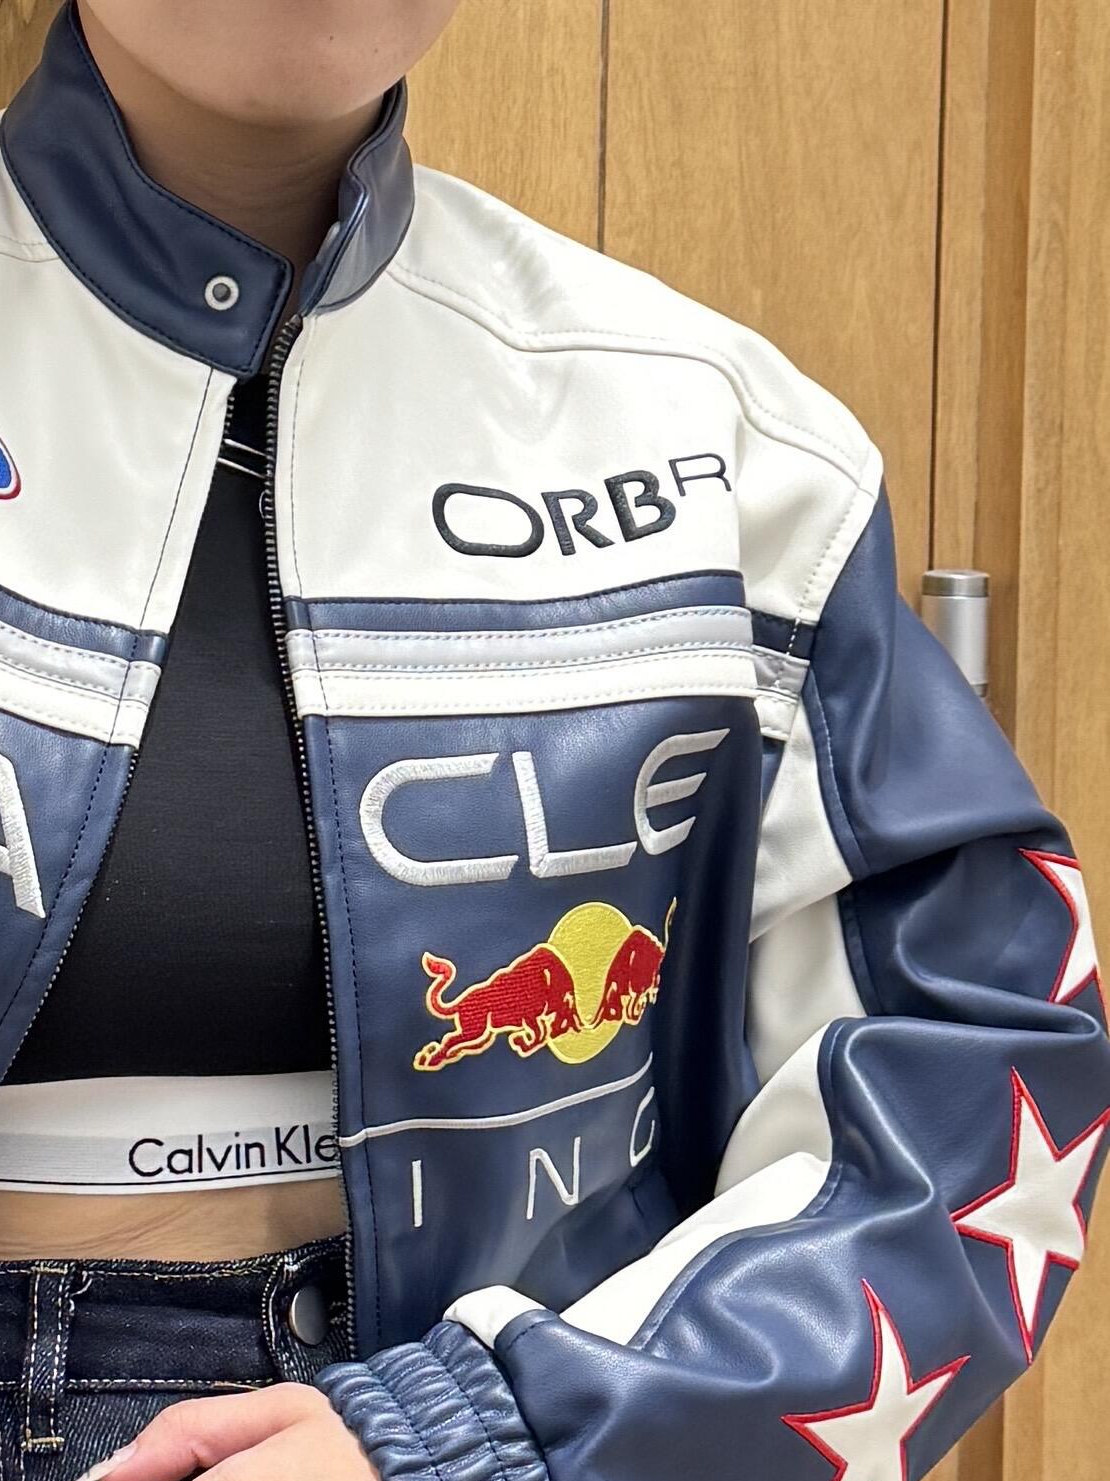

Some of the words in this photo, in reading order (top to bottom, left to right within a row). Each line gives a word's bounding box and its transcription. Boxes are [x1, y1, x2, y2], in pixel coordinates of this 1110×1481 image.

[431, 452, 732, 559] ORBR
[359, 727, 731, 887] CLE
[129, 1132, 266, 1178] Calvin
